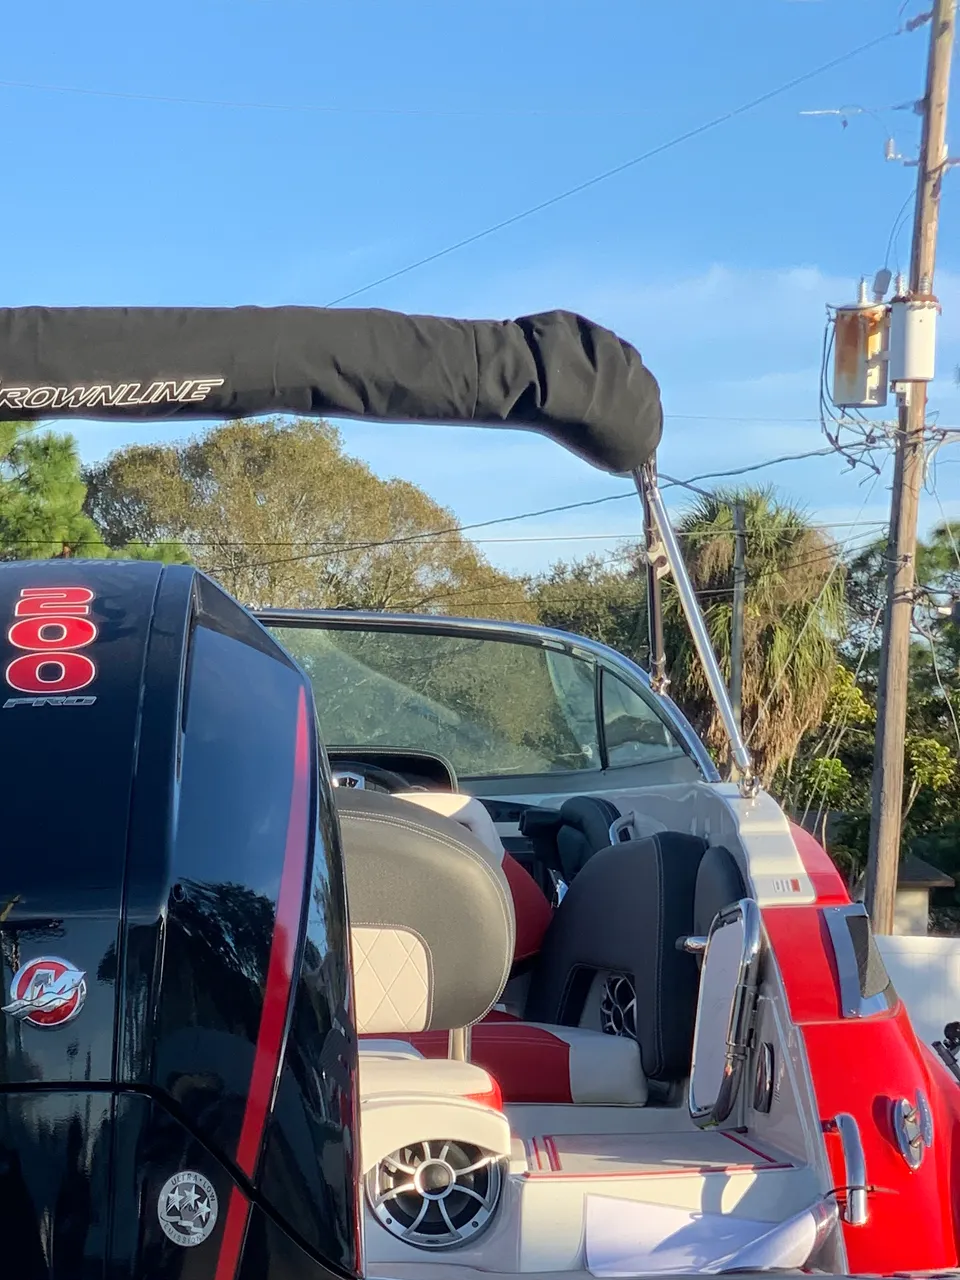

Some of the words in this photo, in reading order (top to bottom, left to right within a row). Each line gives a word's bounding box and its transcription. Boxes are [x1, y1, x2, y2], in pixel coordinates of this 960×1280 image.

[5, 586, 97, 694] 200
[2, 695, 97, 709] PRO
[171, 1173, 198, 1186] ULTRA
[202, 1181, 215, 1202] LOW
